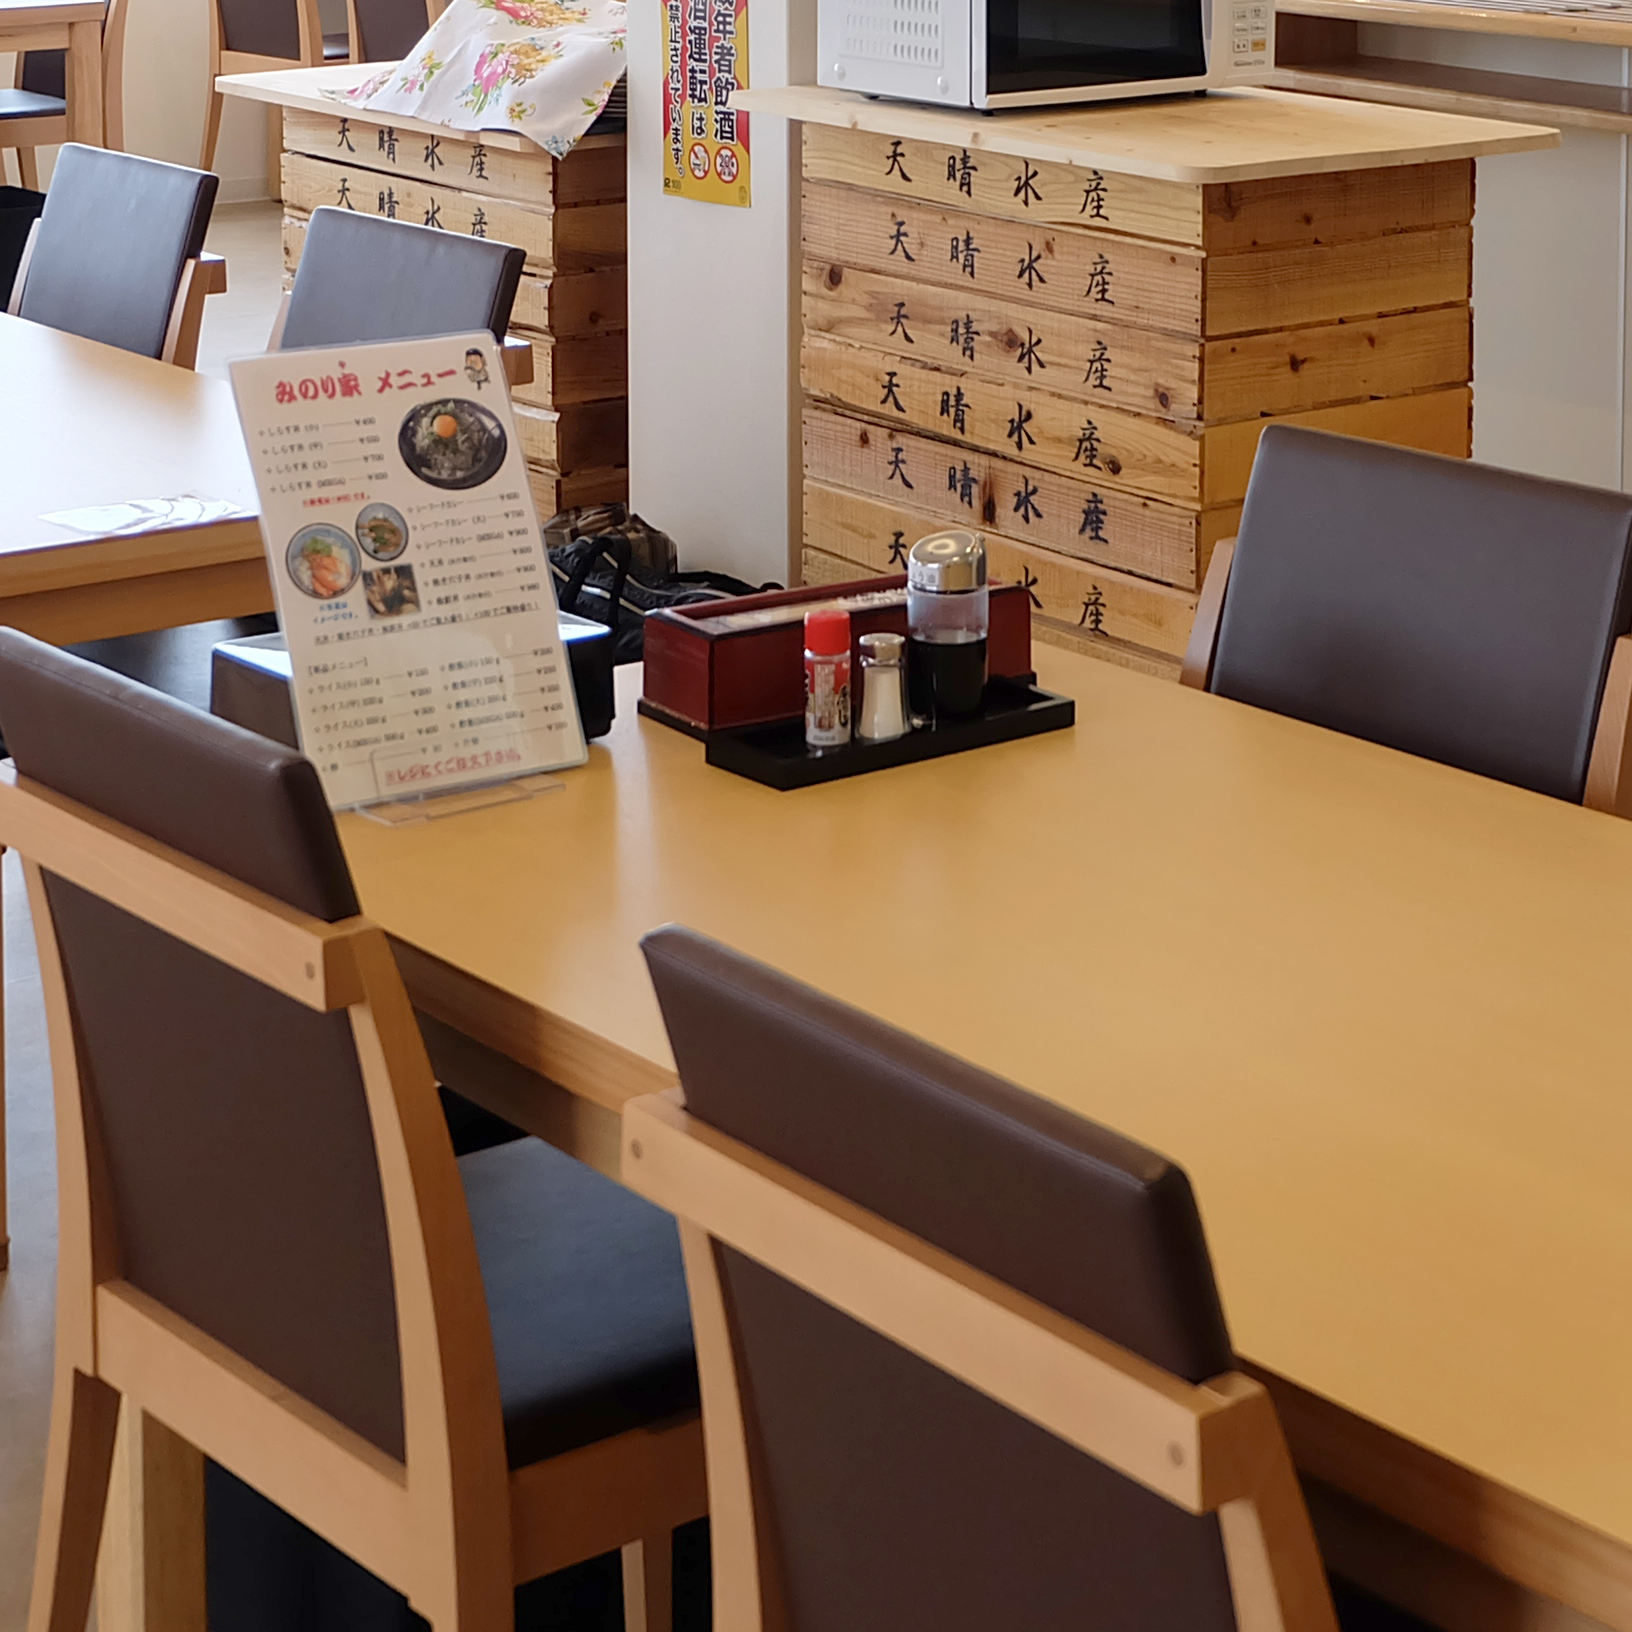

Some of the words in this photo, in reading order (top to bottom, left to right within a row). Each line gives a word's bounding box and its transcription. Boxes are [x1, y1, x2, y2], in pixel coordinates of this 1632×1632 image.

[337, 118, 489, 180] 天晴水産
[884, 139, 1110, 222] 天晴水産
[337, 177, 488, 238] 天晴水産
[888, 219, 1116, 306] 天晴水産
[274, 371, 363, 404] みのり家
[376, 368, 458, 394] メニュー
[888, 301, 1113, 392] 天晴水産
[879, 370, 1104, 473] 天晴水産
[886, 445, 1109, 546] 天晴水産
[887, 530, 1109, 639] 天水産
